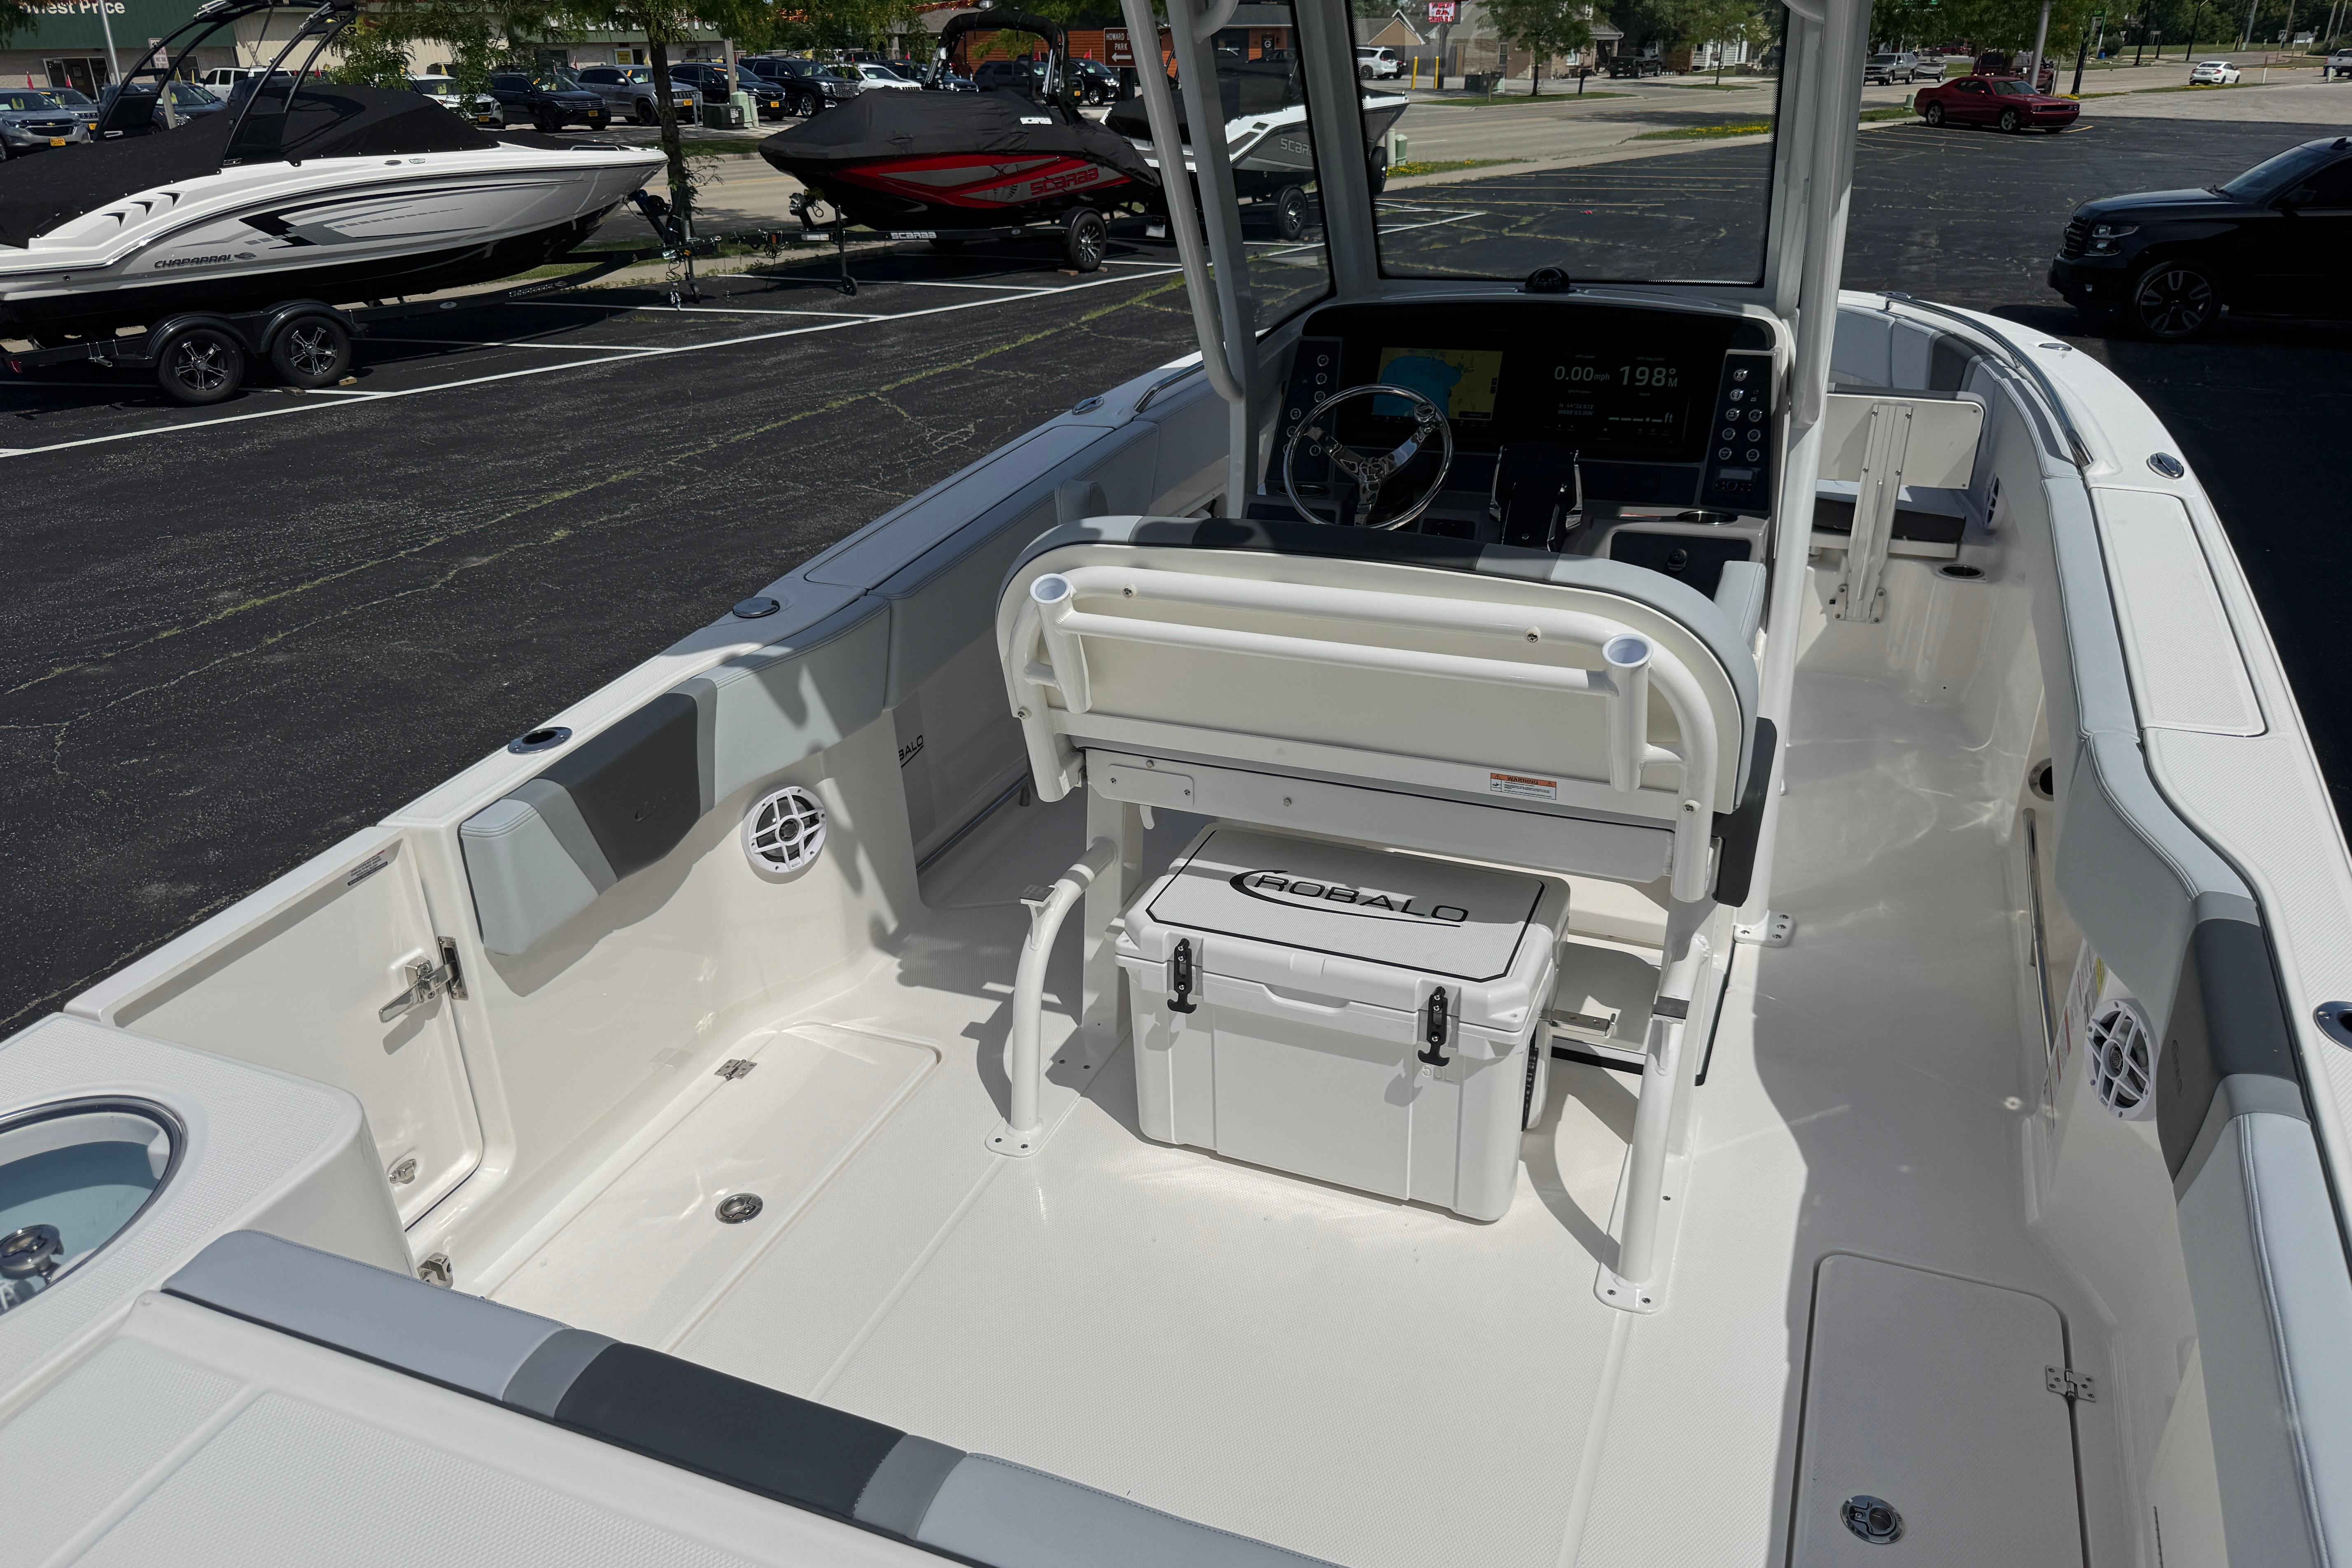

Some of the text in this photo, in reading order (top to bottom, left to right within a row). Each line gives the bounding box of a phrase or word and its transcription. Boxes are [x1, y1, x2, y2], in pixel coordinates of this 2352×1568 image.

[19, 1, 125, 14] owest Prce
[1280, 138, 1312, 156] SCAR
[1030, 168, 1099, 196] SCARAB
[155, 254, 233, 268] CHAPARRAL
[898, 735, 923, 761] BALO
[1507, 776, 1539, 785] WARNING
[1254, 875, 1469, 922] ROBALO
[1422, 1064, 1454, 1083] 50L
